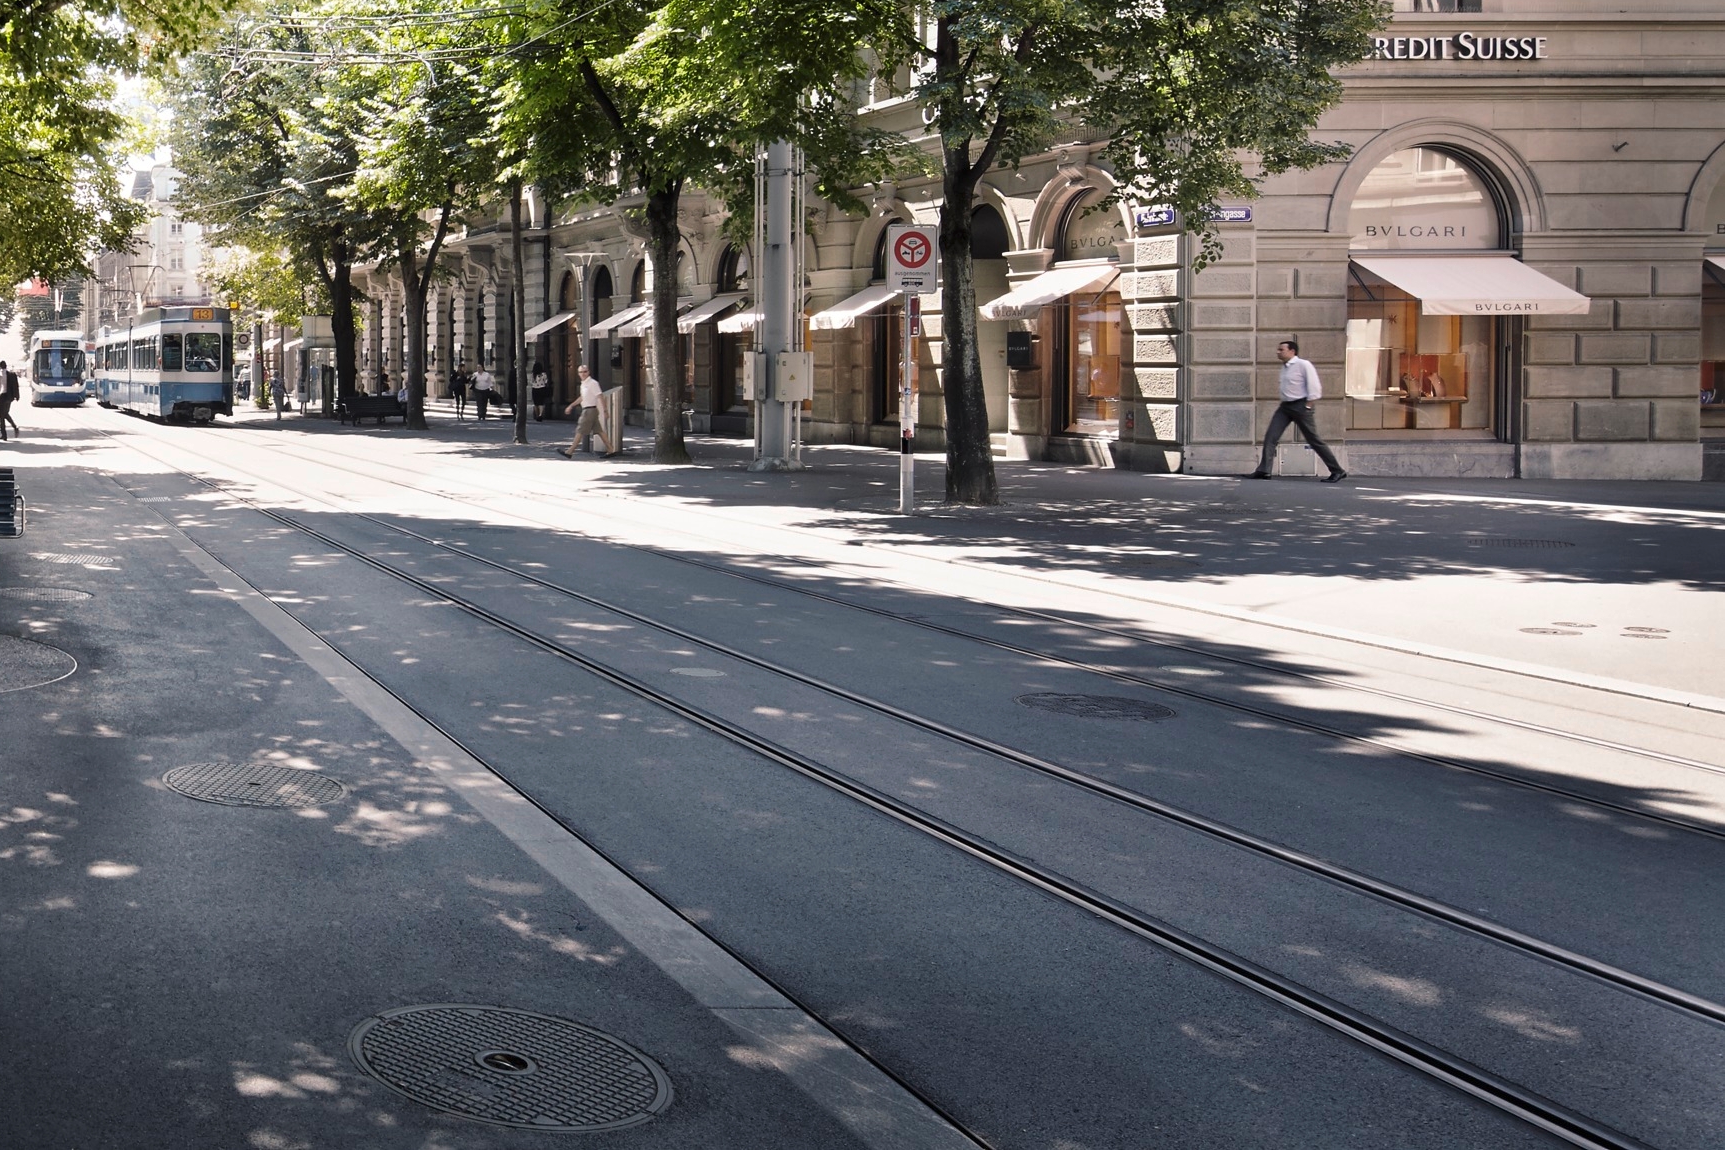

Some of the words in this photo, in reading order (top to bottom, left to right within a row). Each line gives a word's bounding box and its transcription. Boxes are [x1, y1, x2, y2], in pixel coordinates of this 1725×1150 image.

[1458, 31, 1549, 60] SUISSE
[1366, 225, 1466, 237] BVLGARI
[1475, 303, 1539, 311] BVLGARI
[196, 310, 209, 319] 13
